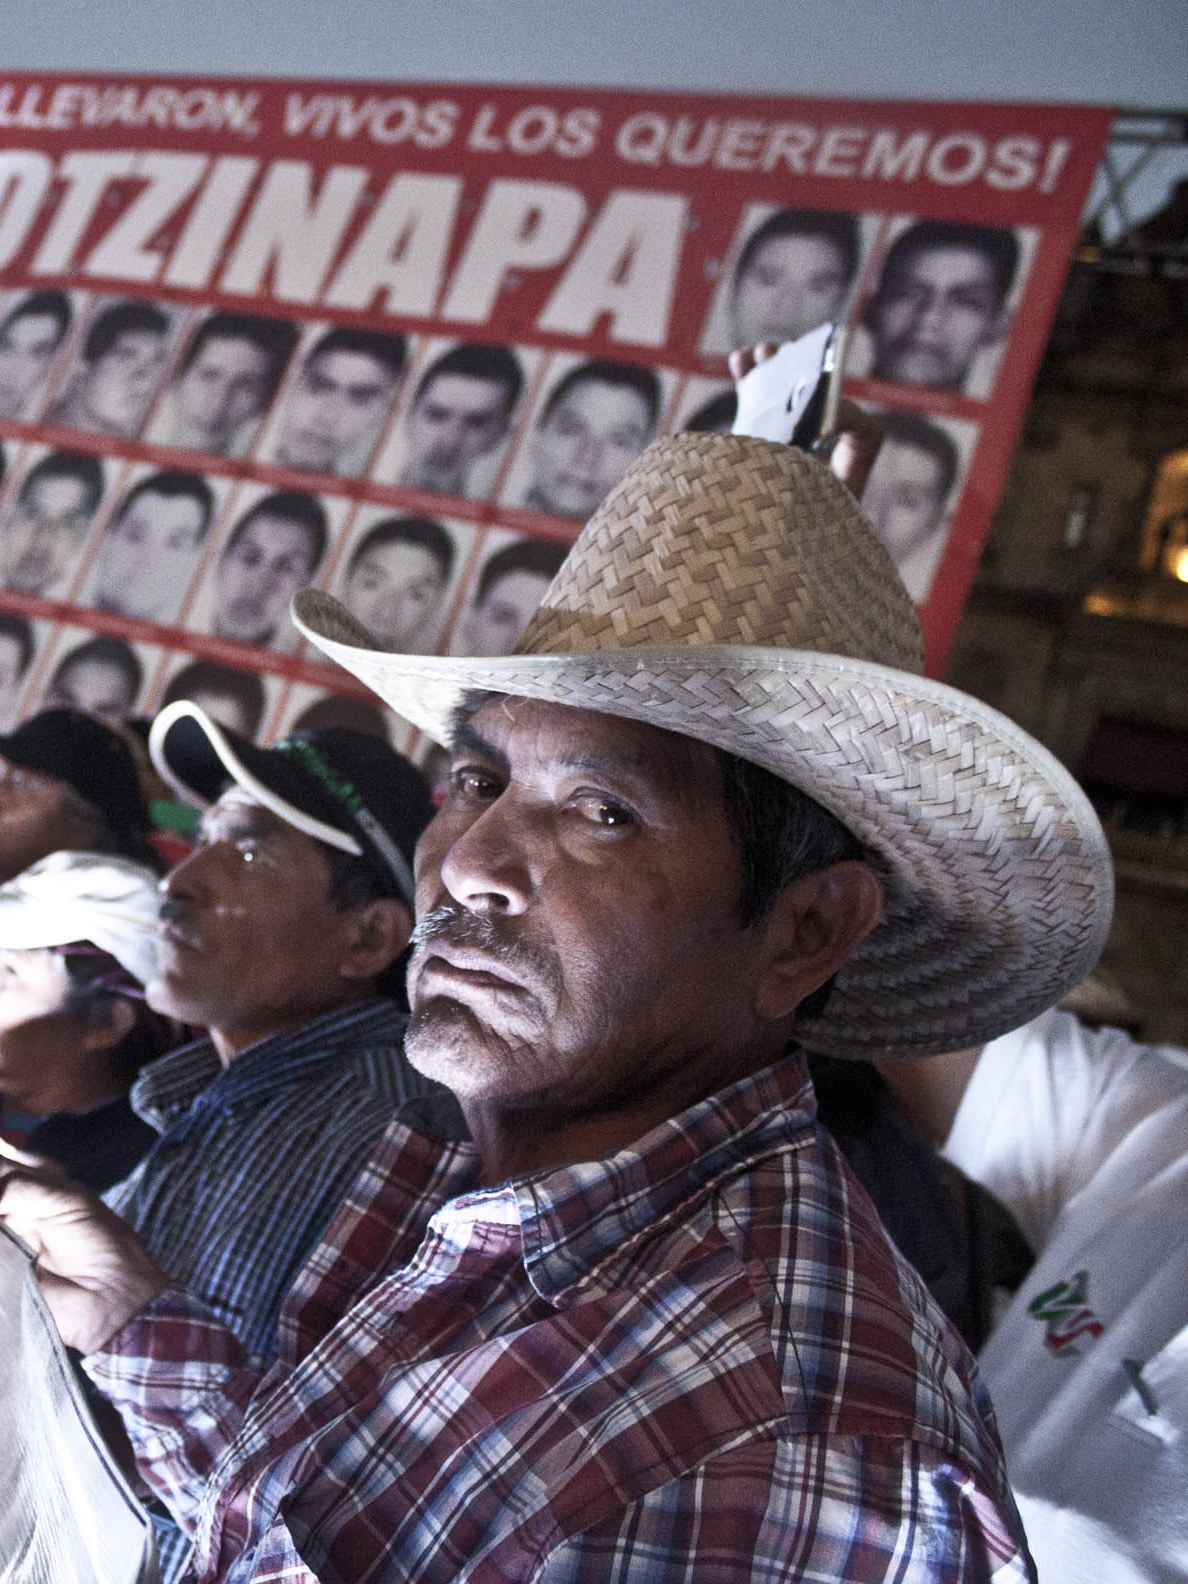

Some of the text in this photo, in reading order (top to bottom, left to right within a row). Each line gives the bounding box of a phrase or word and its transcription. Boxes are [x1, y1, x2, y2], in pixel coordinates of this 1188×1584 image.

[284, 92, 461, 149] VIVOS
[467, 101, 603, 160] LOS
[614, 112, 1072, 195] QUEREMOS!
